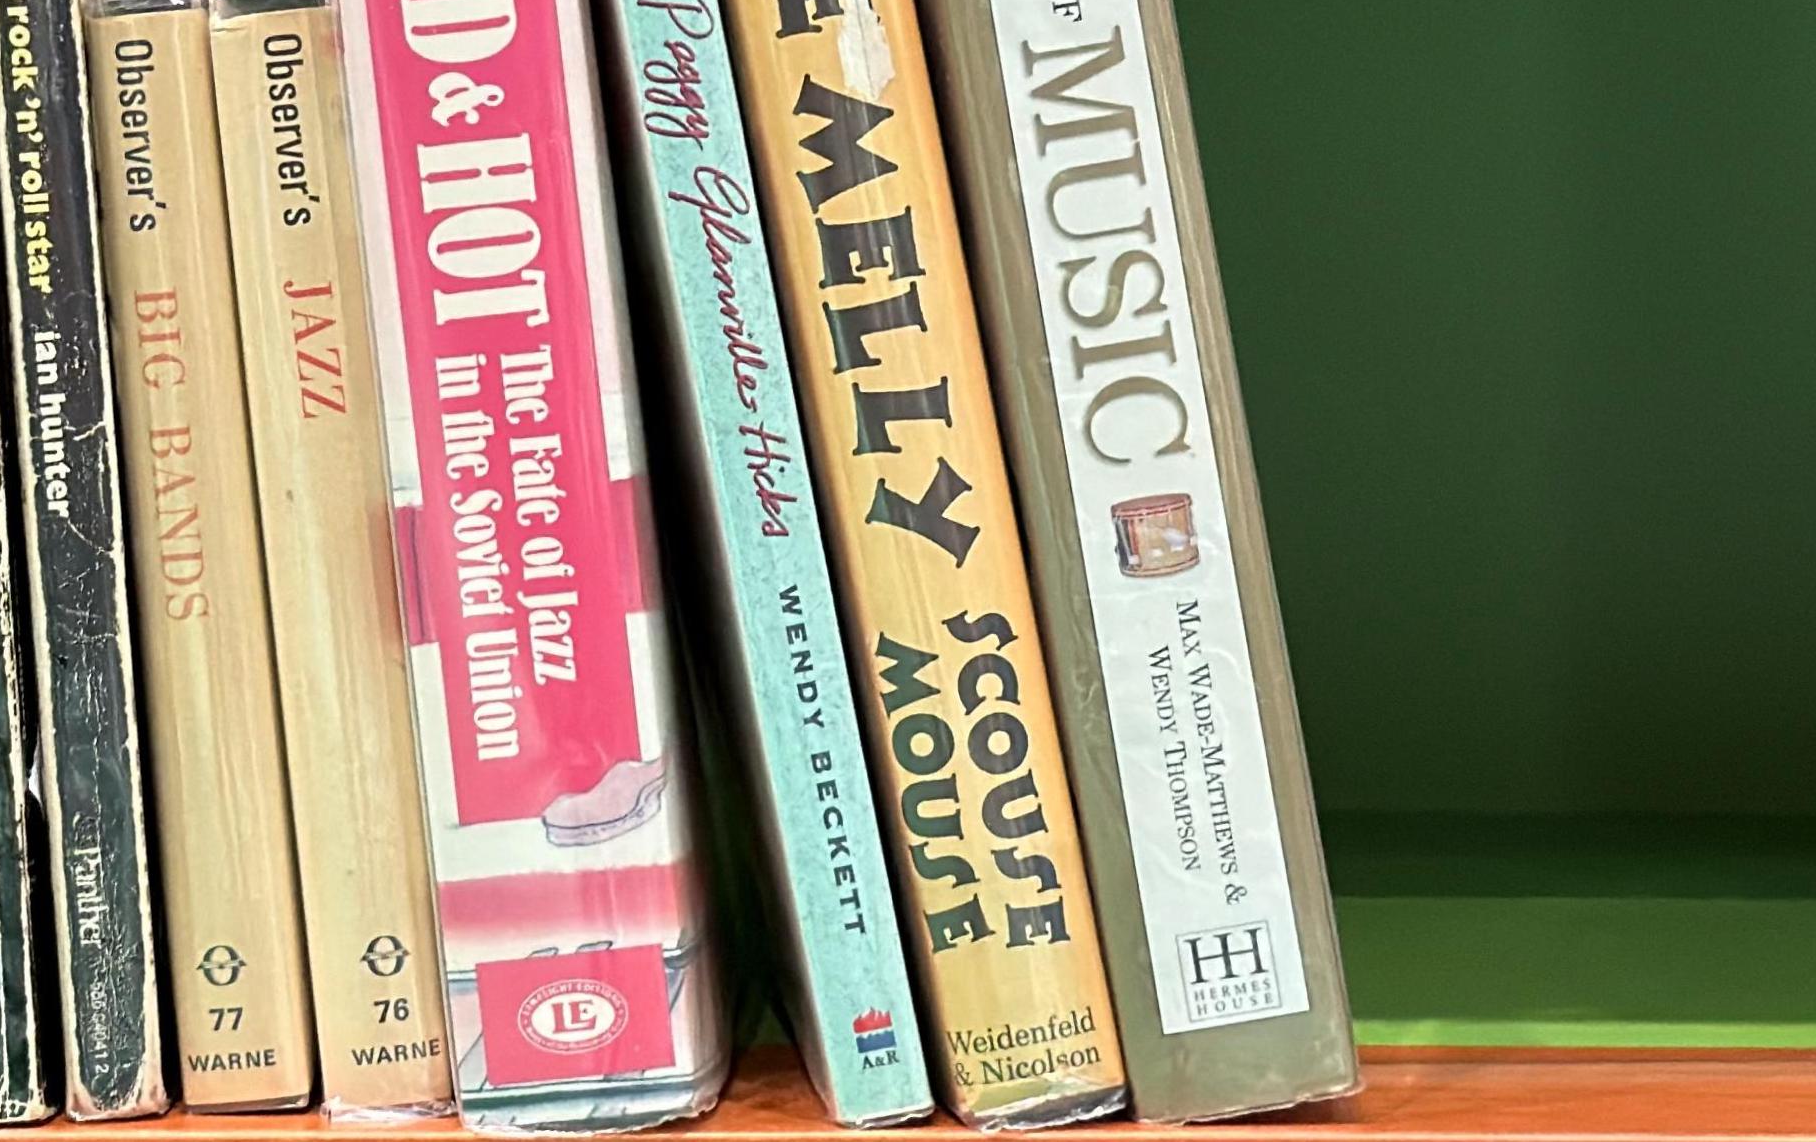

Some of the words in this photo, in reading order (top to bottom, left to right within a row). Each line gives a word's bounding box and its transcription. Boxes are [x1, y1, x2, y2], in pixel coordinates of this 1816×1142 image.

[8, 1, 40, 92] rock
[115, 39, 167, 233] Observer's
[263, 33, 320, 227] Observer's
[428, 71, 505, 128] &
[18, 148, 51, 215] roll
[24, 218, 54, 294] star
[417, 131, 551, 330] HOT
[1021, 24, 1192, 466] MUSIC
[34, 330, 62, 385] ian
[133, 286, 185, 390] BIG
[283, 279, 347, 419] JAZZ
[791, 73, 981, 569] MELLY
[435, 353, 487, 401] in
[500, 344, 554, 424] The
[37, 389, 70, 518] hunter
[441, 410, 495, 479] the
[509, 433, 567, 526] Fate
[738, 421, 797, 537] Hicks
[148, 425, 210, 623] BANDS
[450, 489, 514, 618] Soviet
[521, 537, 575, 580] of
[516, 591, 578, 685] Jazz
[1175, 599, 1202, 656] MAX
[466, 628, 522, 760] Union
[1148, 644, 1177, 734] WENDY
[778, 584, 825, 729] WENDY
[813, 751, 867, 935] BECKETT
[874, 631, 997, 954] MOUSE
[942, 610, 1071, 949] SCOUSE
[1187, 663, 1238, 877] WADE-MATTHEWS
[1162, 742, 1201, 872] THOMPSON
[1225, 883, 1248, 904] &
[209, 1007, 244, 1032] 77
[374, 999, 410, 1025] 76
[946, 1006, 1096, 1058] Weidenfeld
[1194, 978, 1272, 1002] HERMES
[1196, 992, 1274, 1016] HOUSE
[188, 1049, 277, 1072] WARNE
[352, 1037, 442, 1066] WARNE
[861, 1049, 900, 1071] A&R
[954, 1062, 974, 1088] &
[982, 1043, 1101, 1085] Nicolson
